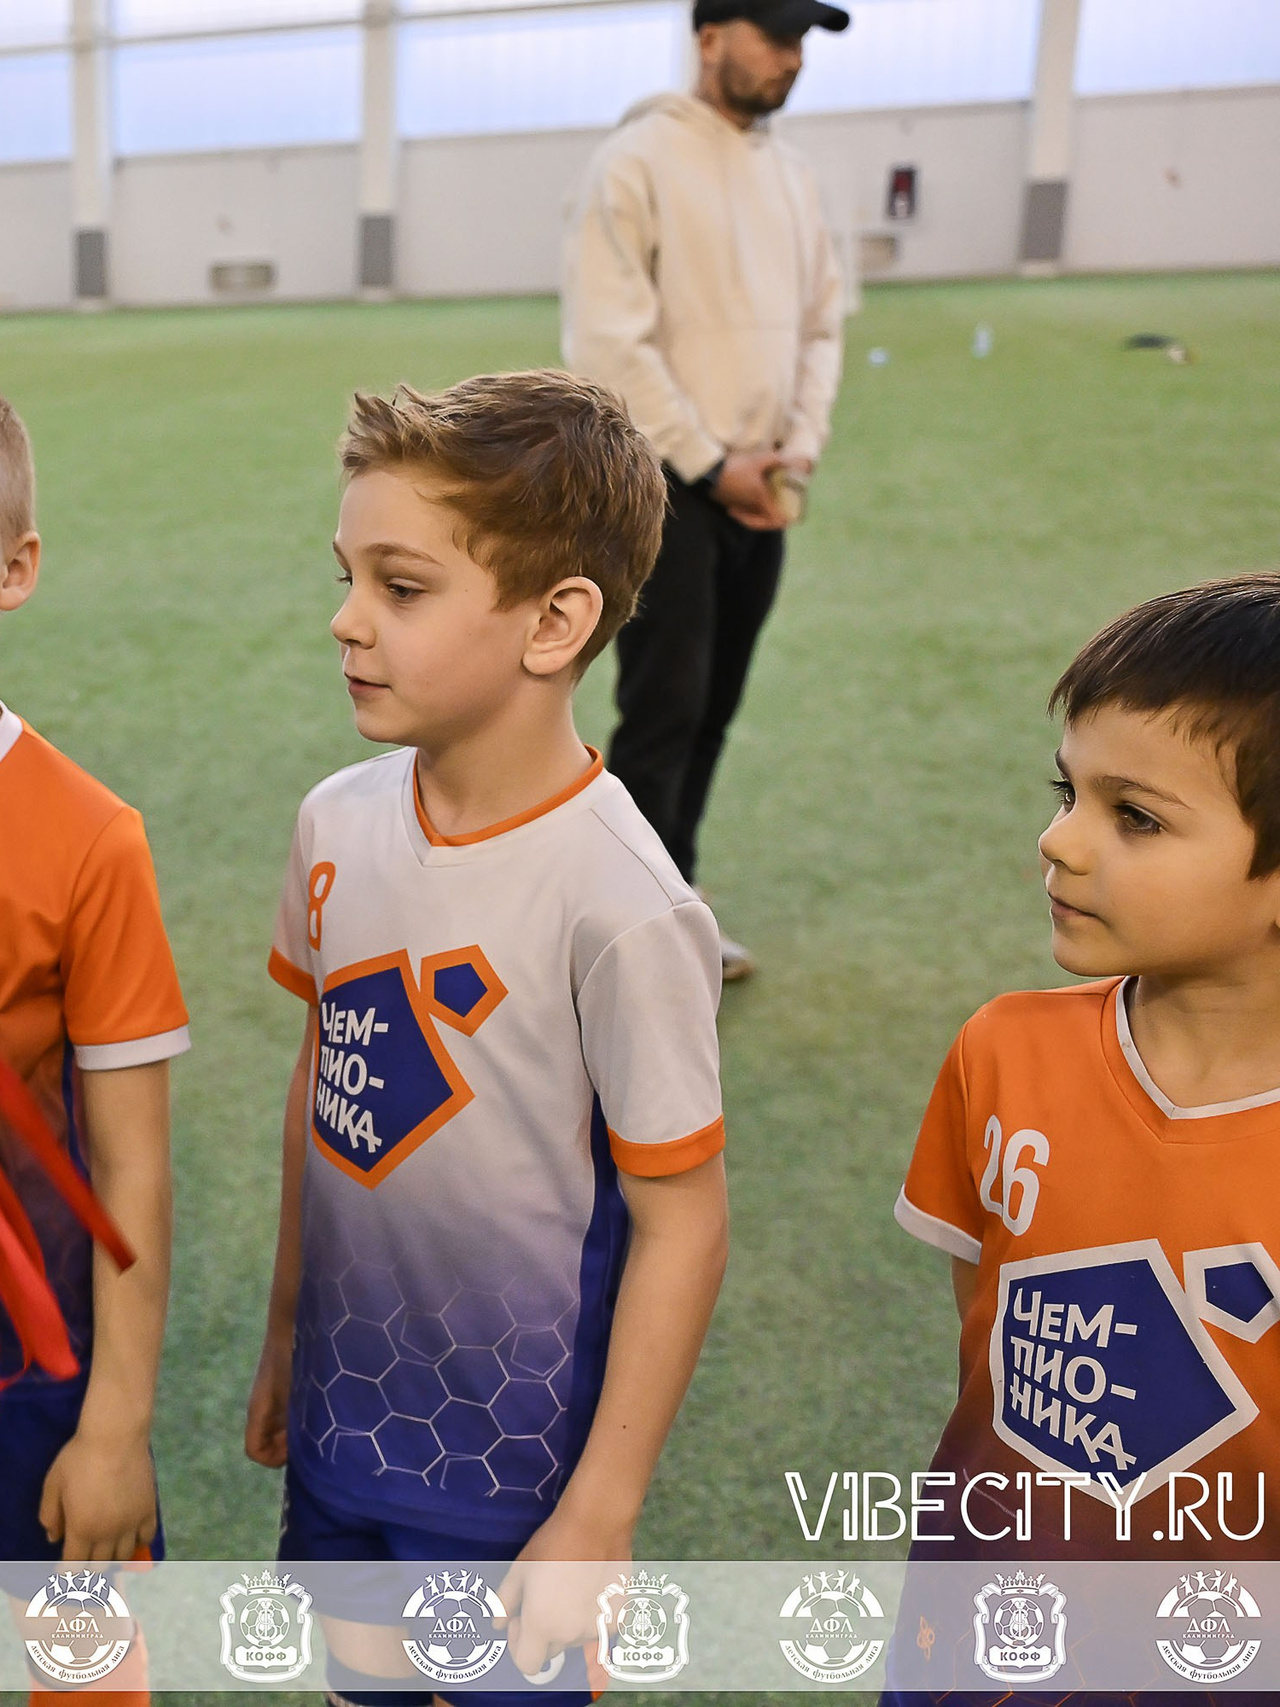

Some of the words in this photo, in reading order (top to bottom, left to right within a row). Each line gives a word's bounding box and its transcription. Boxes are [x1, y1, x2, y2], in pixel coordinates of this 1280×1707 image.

[308, 861, 337, 952] 8
[321, 1002, 389, 1046] ЧЕМ-
[320, 1045, 385, 1096] ПИО-
[316, 1079, 382, 1153] НИКА
[980, 1114, 1050, 1236] 26
[1013, 1287, 1138, 1348] ЧЕМ-
[1010, 1336, 1137, 1404] ПИО-
[1010, 1374, 1137, 1471] НИКА
